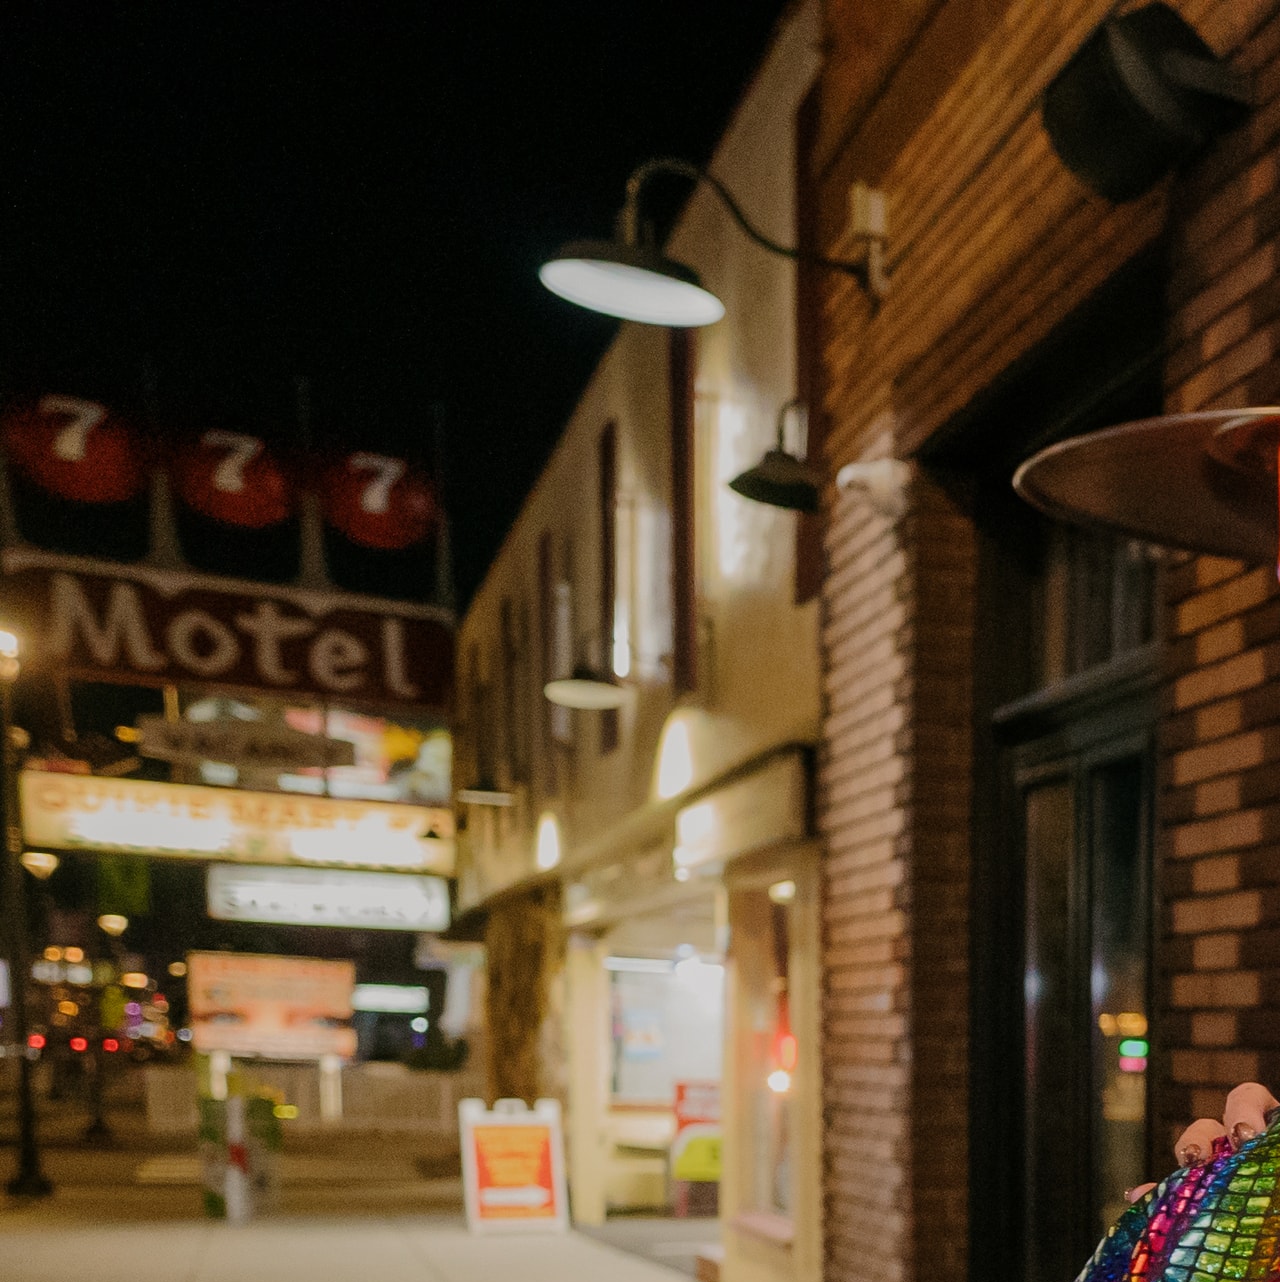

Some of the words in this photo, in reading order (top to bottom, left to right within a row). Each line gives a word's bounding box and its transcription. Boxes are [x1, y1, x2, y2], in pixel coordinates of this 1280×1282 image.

[40, 394, 105, 462] 7
[203, 428, 264, 493] 7
[347, 451, 406, 514] 7
[51, 572, 420, 700] Motel
